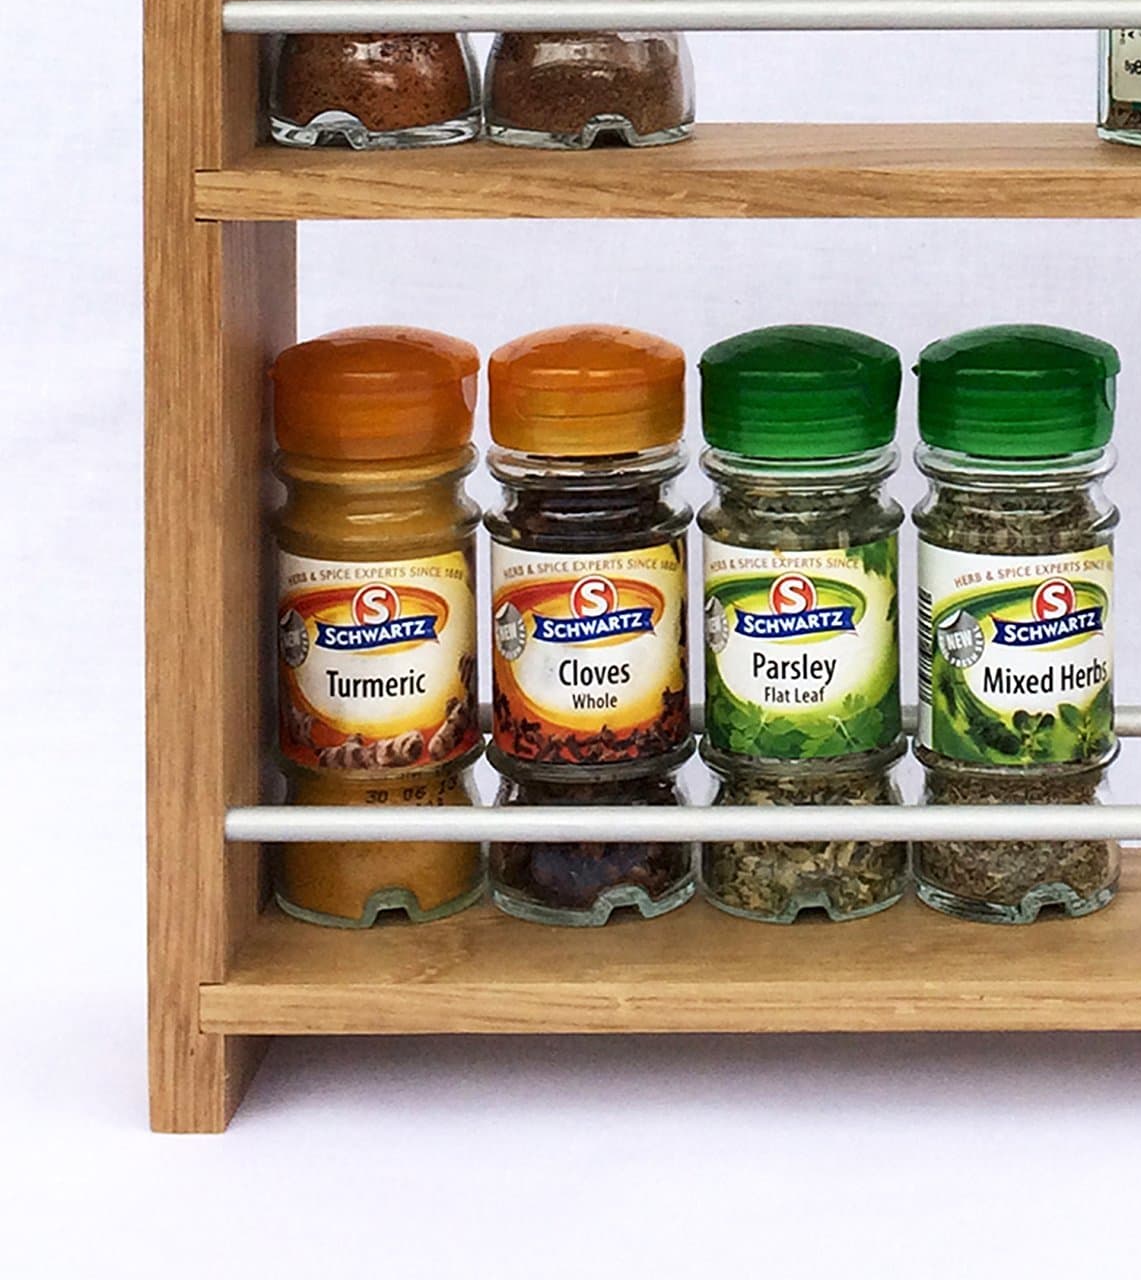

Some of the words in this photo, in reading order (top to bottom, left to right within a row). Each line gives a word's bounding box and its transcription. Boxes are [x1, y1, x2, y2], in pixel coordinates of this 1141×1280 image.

[320, 569, 350, 581] SPICE
[355, 567, 406, 578] EXPERTS
[412, 566, 441, 577] SINCE
[537, 562, 568, 574] SPICE
[573, 560, 623, 571] EXPERTS
[627, 559, 657, 570] SINCE
[738, 558, 769, 569] SPICE
[772, 558, 822, 569] EXPERTS
[826, 558, 859, 569] SINCE
[954, 573, 983, 588] HERB
[986, 571, 994, 581] &
[997, 566, 1031, 579] SPICE
[1036, 561, 1081, 575] EXPERTS
[362, 589, 390, 625] S
[581, 582, 608, 617] S
[779, 579, 807, 614] S
[1042, 585, 1068, 620] S
[325, 620, 426, 646] SCHWARTZ
[543, 613, 642, 638] SCHWARTZ
[744, 611, 843, 634] SCHWARTZ
[1004, 612, 1096, 643] SCHWARTZ
[946, 629, 973, 651] NEW
[559, 659, 630, 686] Cloves
[753, 652, 837, 686] Parsley
[983, 666, 1054, 694] Mixed
[1060, 658, 1108, 691] Herbs
[326, 669, 426, 698] Turmeric
[764, 686, 790, 703] Flat
[794, 686, 826, 703] Leaf
[572, 694, 618, 710] Whole
[365, 790, 388, 804] 30
